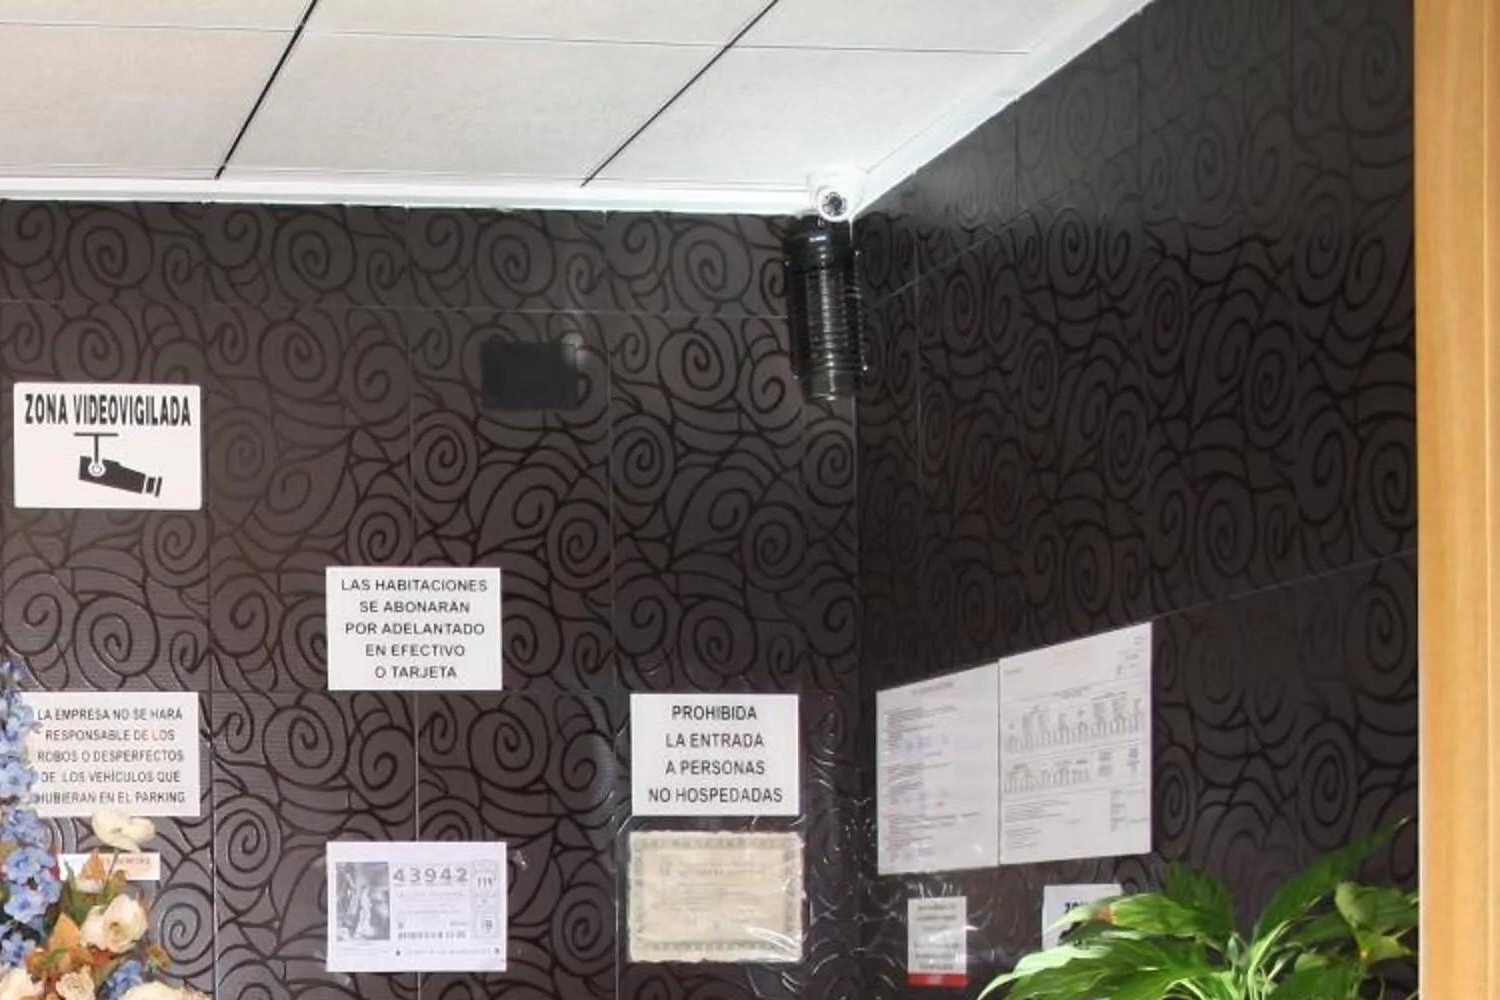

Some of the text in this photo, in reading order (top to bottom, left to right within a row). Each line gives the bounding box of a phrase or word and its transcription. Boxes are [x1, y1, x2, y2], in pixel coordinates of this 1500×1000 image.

[24, 393, 191, 427] ZONA VIDEOVIGILADA
[341, 579, 488, 592] LAS HABITACIONES
[359, 601, 378, 613] SE
[345, 622, 485, 635] POR ADELANTADO
[365, 644, 465, 657] EN EFECTIVO
[375, 666, 457, 679] O TARJETA
[37, 708, 52, 720] LA
[55, 708, 110, 720] EMPRESA
[113, 708, 130, 720] NO
[133, 708, 147, 720] SE
[672, 705, 757, 720] PROHIBIDA
[45, 729, 175, 741] RESPONSABLE DE LOS
[665, 733, 765, 748] LA ENTRADA
[37, 750, 184, 762] ROBOS O DESPERFECTOS
[665, 760, 765, 775] A PERSONAS
[42, 771, 56, 782] DE
[62, 770, 85, 782] LOS
[157, 770, 181, 783] QUE
[99, 791, 116, 804] EN
[119, 791, 132, 804] EL
[135, 791, 185, 804] PARKING
[649, 788, 783, 802] NO HOSPEDADAS
[393, 867, 468, 883] 43942
